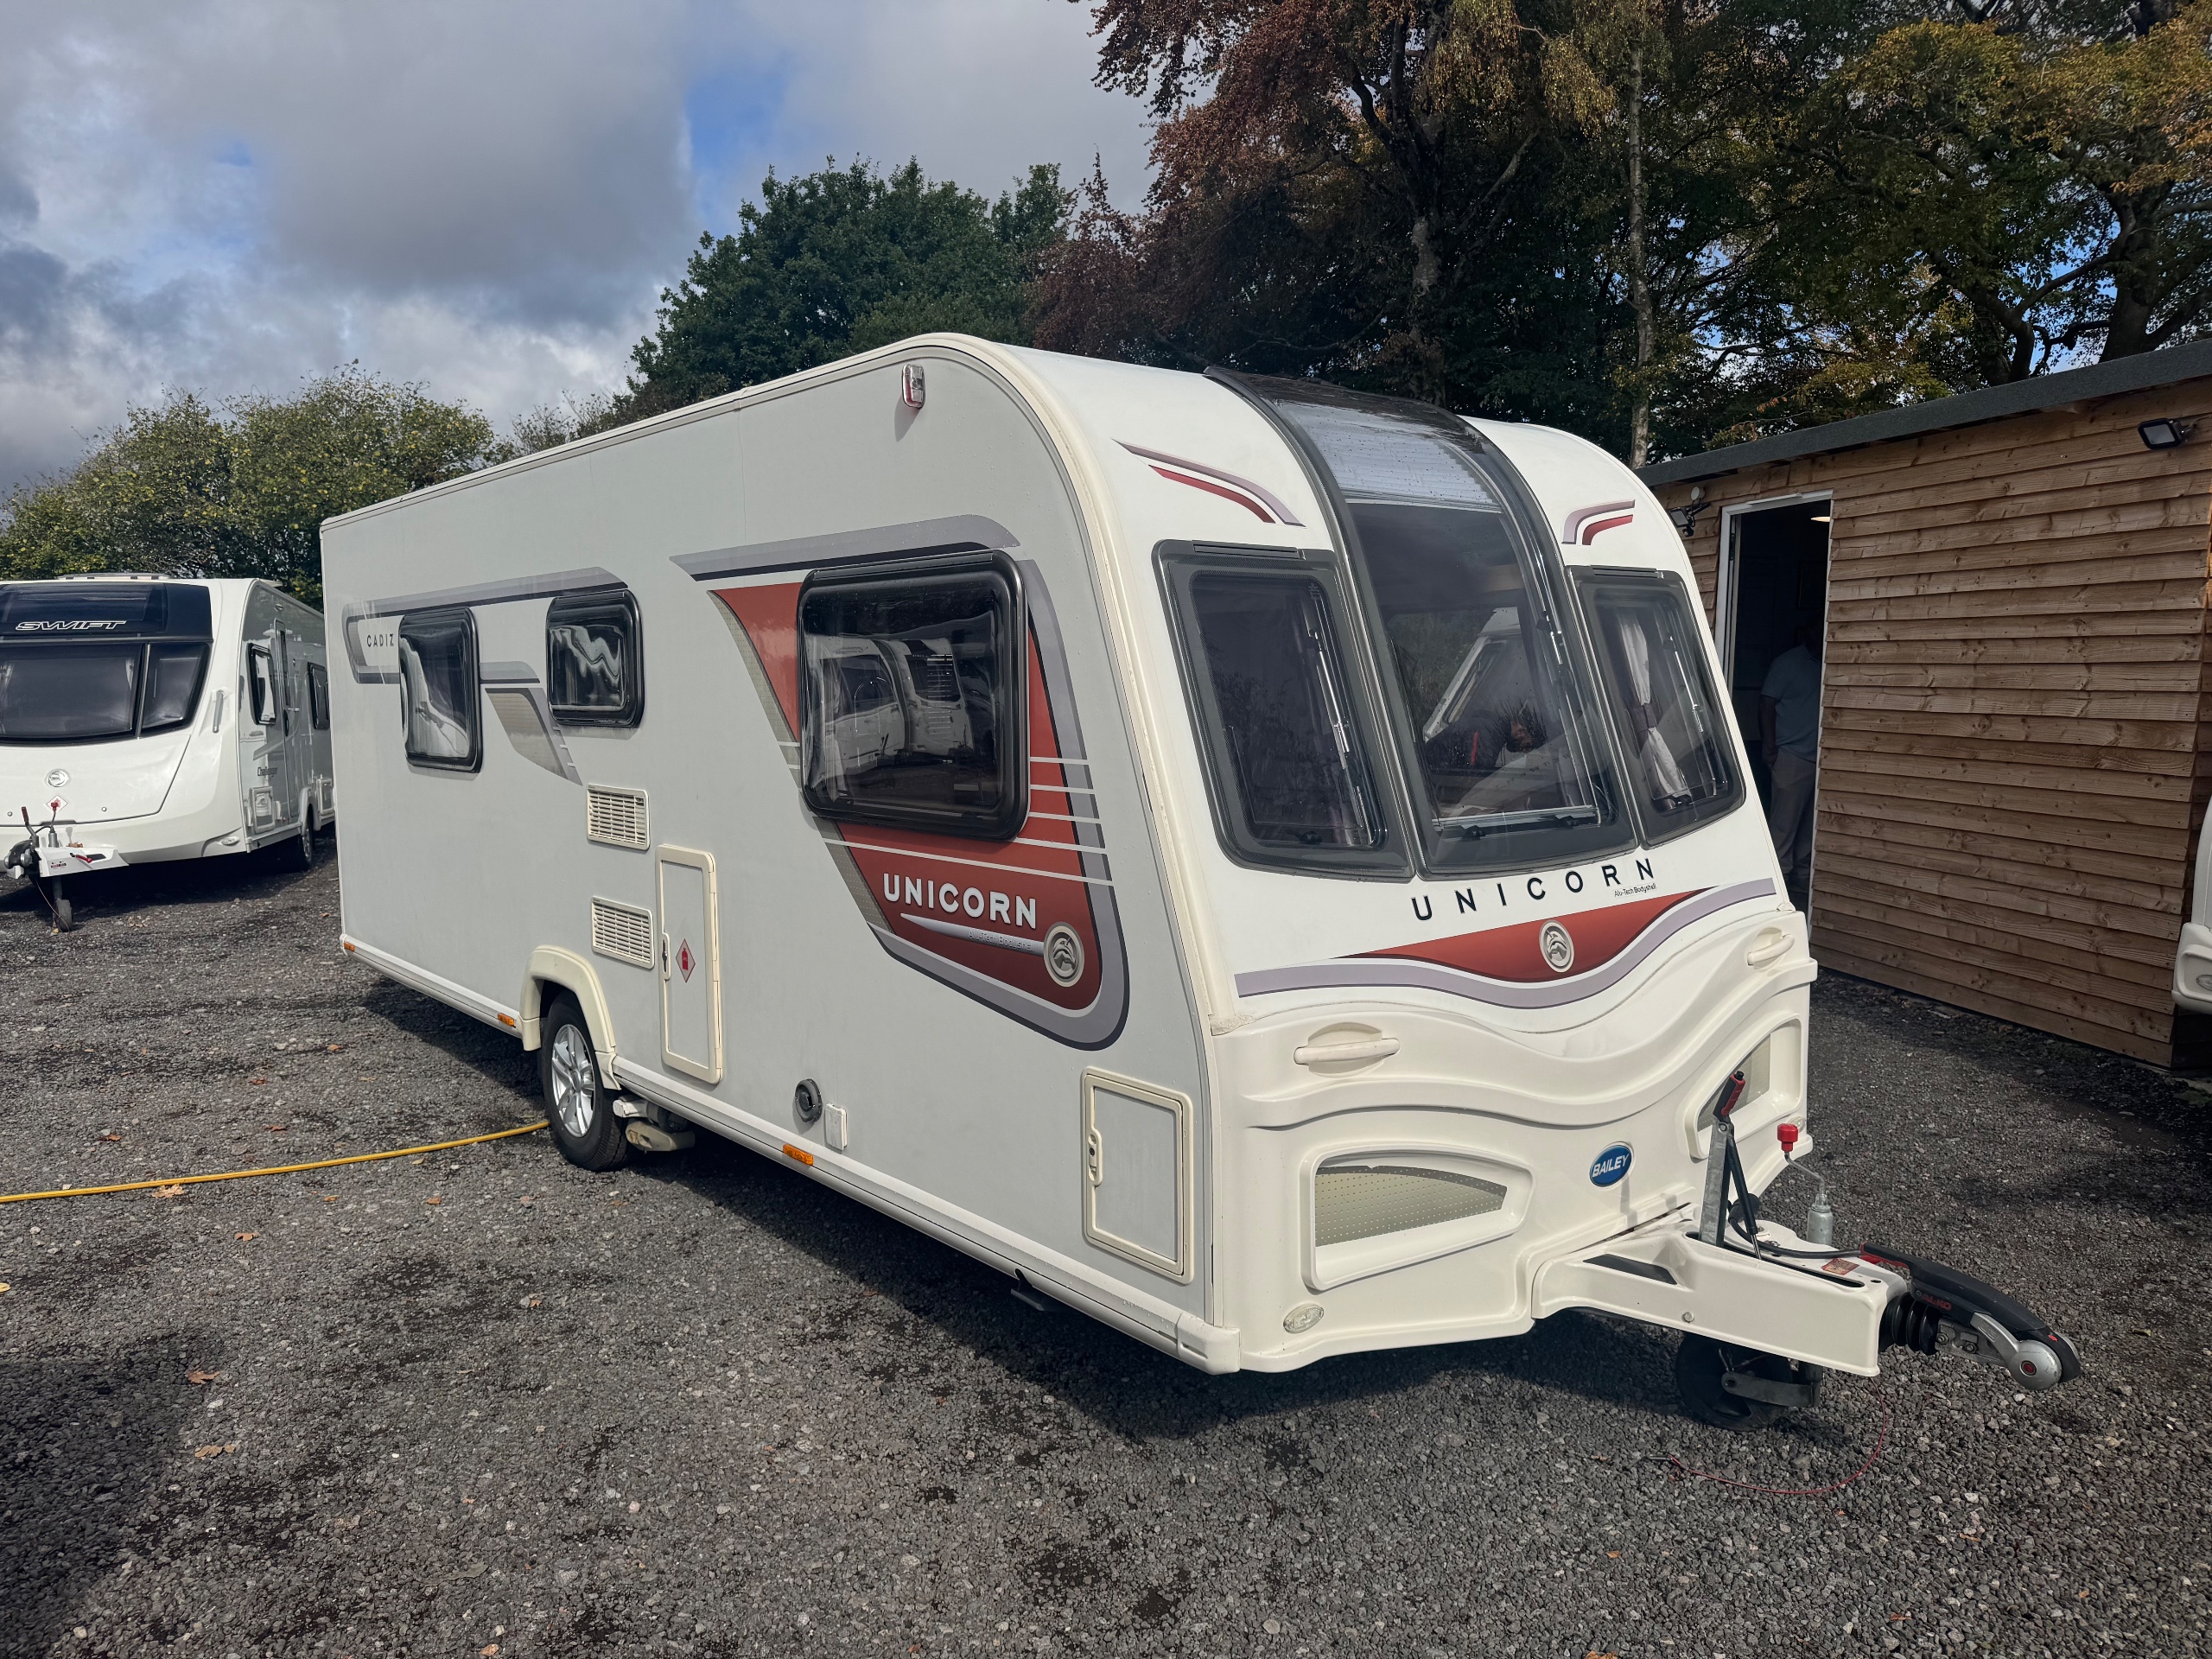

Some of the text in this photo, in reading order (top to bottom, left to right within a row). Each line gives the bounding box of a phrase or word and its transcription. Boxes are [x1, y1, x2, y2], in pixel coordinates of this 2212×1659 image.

[16, 620, 127, 631] SWIFT
[366, 633, 394, 648] CADIZ
[1410, 857, 1655, 921] UNICORN
[883, 873, 1037, 930] UNICORN
[968, 929, 997, 944] Alu-Tech
[1592, 1153, 1630, 1178] BAILEY
